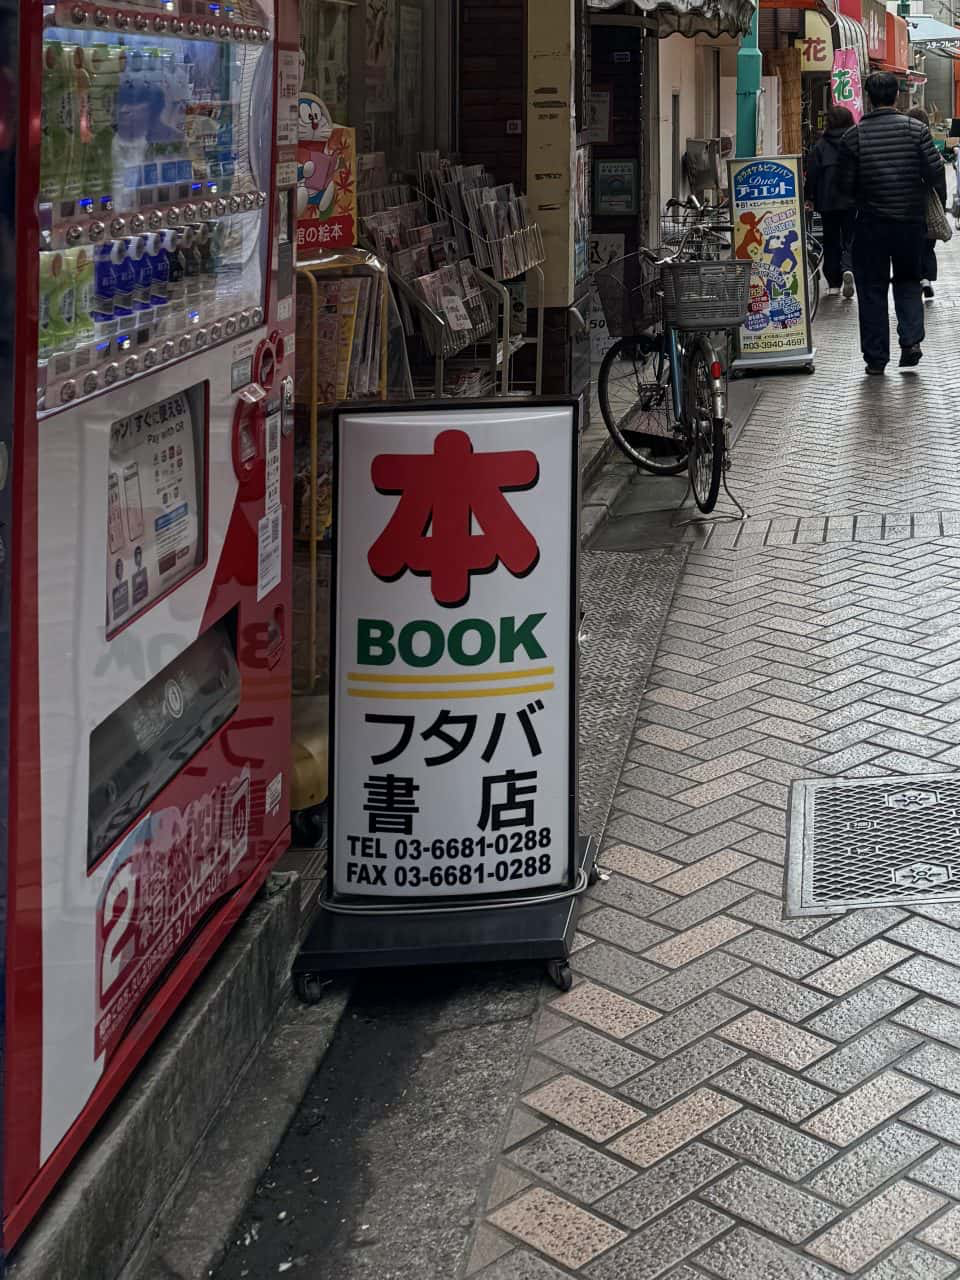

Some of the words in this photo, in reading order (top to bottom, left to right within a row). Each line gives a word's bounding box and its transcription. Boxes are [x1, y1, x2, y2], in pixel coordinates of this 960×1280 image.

[802, 37, 827, 62] 花
[832, 70, 854, 102] 花
[736, 182, 793, 199] デュエット
[749, 176, 778, 186] Duet
[147, 434, 160, 446] Pay
[162, 428, 174, 440] with
[367, 429, 540, 608] 本
[356, 612, 548, 668] BOOK
[364, 699, 545, 767] フタバ
[346, 835, 388, 860] TEL
[394, 827, 552, 861] 03-6681-0288
[346, 862, 388, 887] FAX
[394, 854, 552, 888] 03-6681-0288
